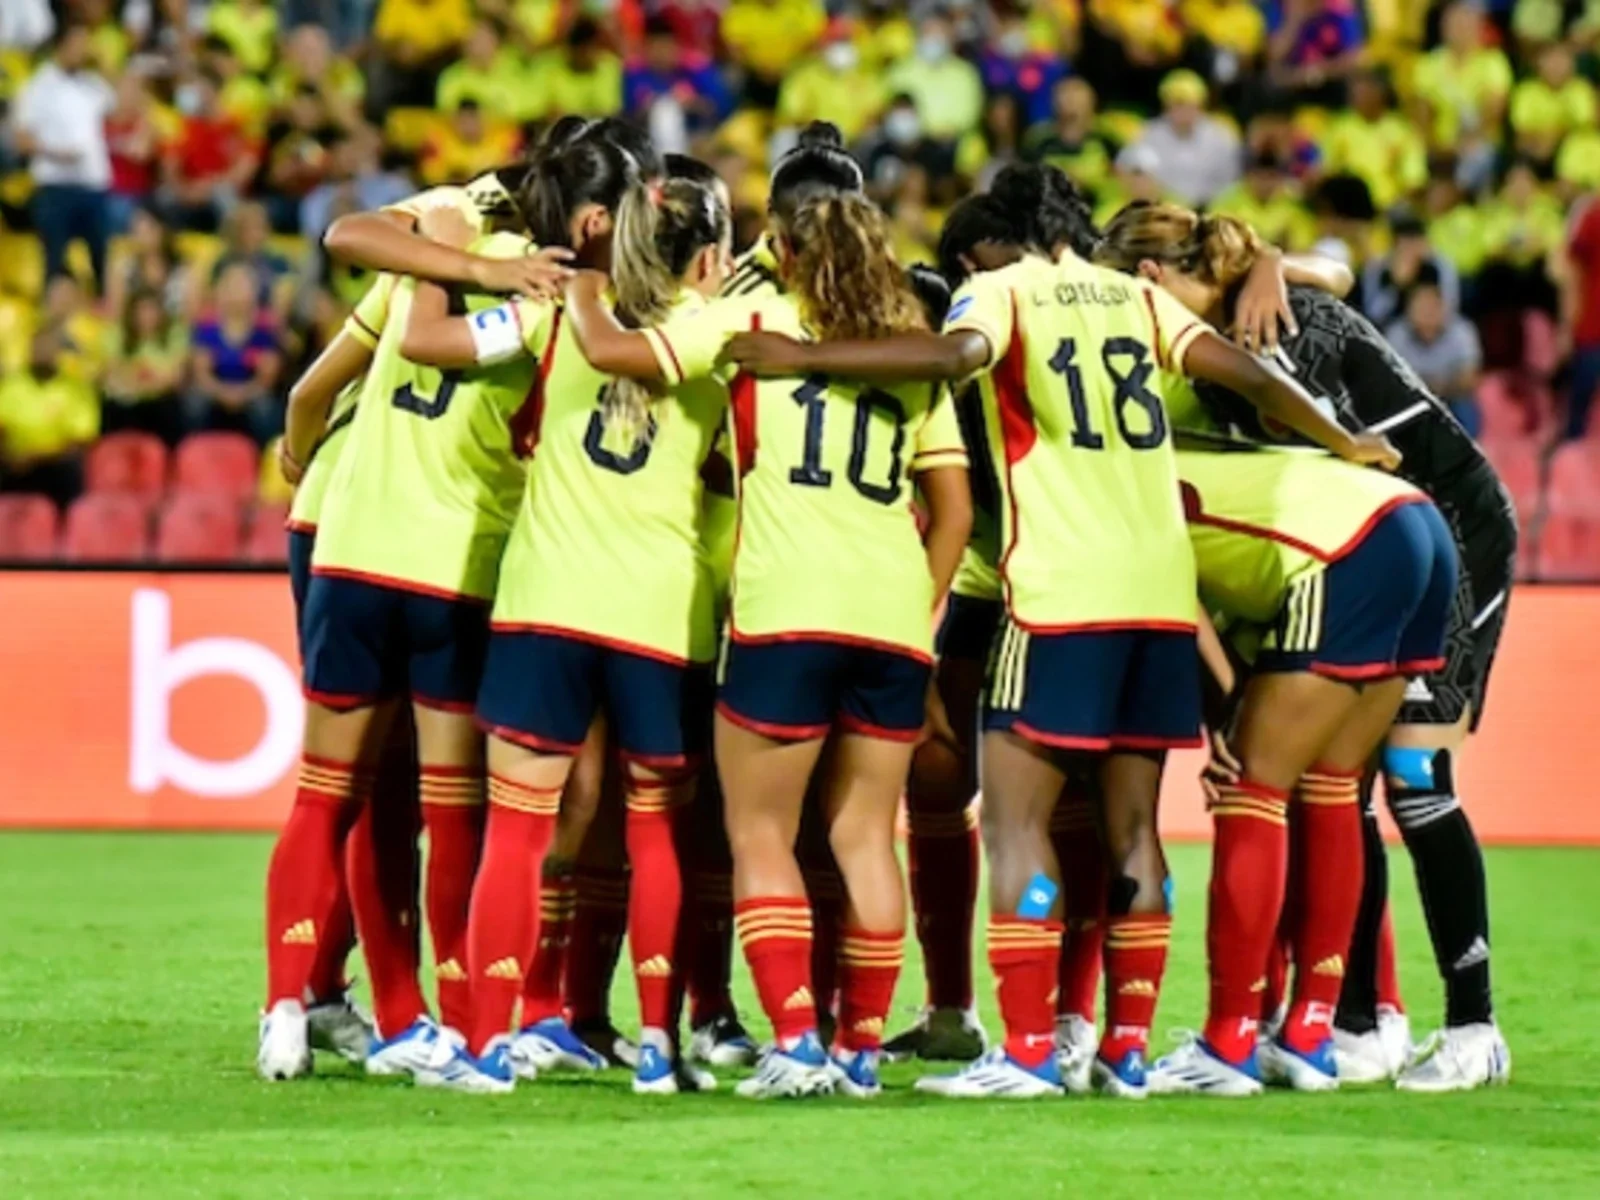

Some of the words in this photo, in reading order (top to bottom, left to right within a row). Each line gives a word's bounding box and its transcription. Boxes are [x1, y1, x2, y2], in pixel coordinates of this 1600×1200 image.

[475, 307, 507, 330] C
[789, 374, 906, 506] 10
[1047, 336, 1166, 451] 18
[129, 587, 306, 799] b
